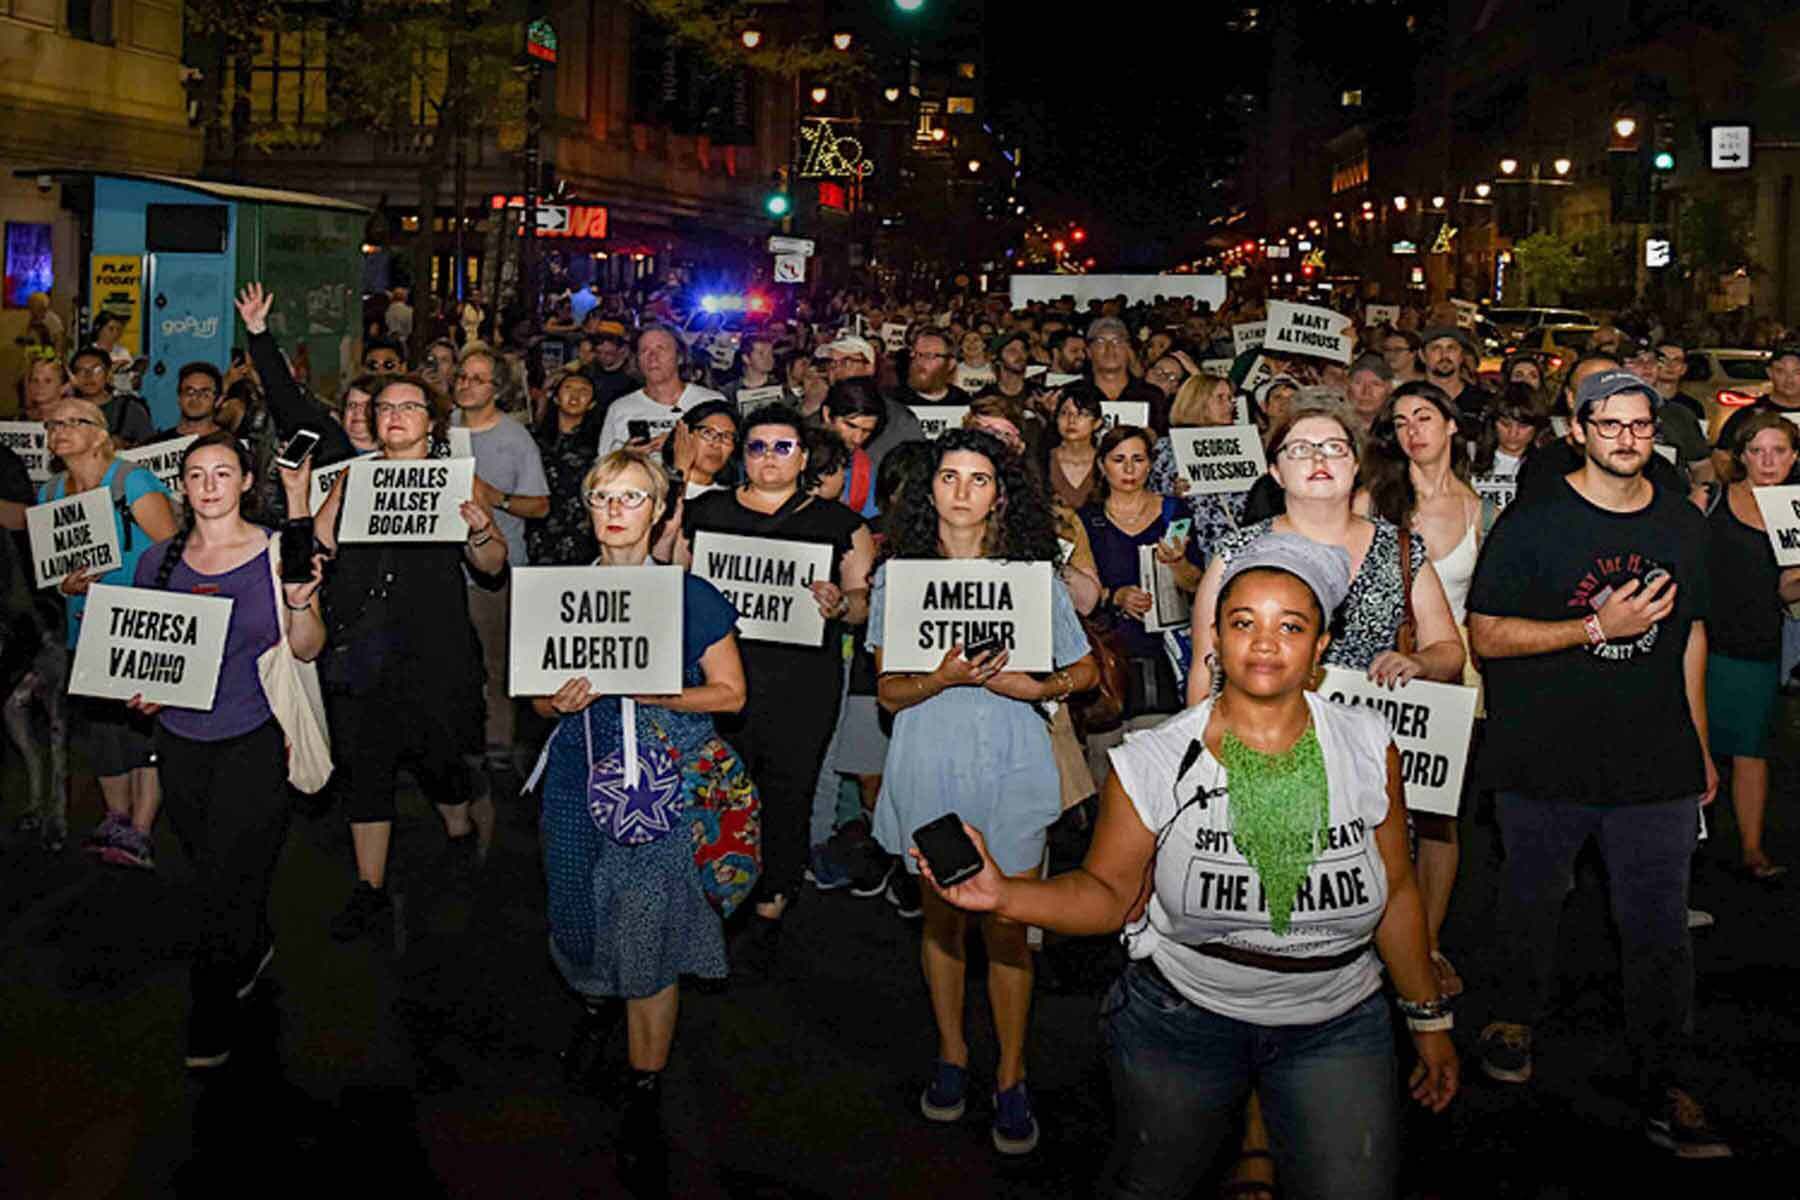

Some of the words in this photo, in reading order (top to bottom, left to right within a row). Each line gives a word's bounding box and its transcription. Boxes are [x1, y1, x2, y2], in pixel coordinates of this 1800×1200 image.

[102, 263, 134, 273] PLAY
[96, 275, 137, 286] TODAY
[1277, 327, 1341, 351] ALTHOUSE
[1192, 437, 1243, 458] GEORGE
[373, 467, 449, 489] CHARLES
[1187, 460, 1259, 482] WOESSNER
[374, 491, 441, 511] HALSEY
[368, 514, 440, 536] BOGART
[708, 551, 796, 588] WILLIAM
[560, 590, 632, 624] SADIE
[922, 580, 1014, 611] AMELIA
[110, 606, 197, 646] THERESA
[541, 635, 650, 671] ALBERTO
[1194, 827, 1234, 855] SPIT
[1199, 870, 1249, 913] THE
[1258, 866, 1370, 913] RADE
